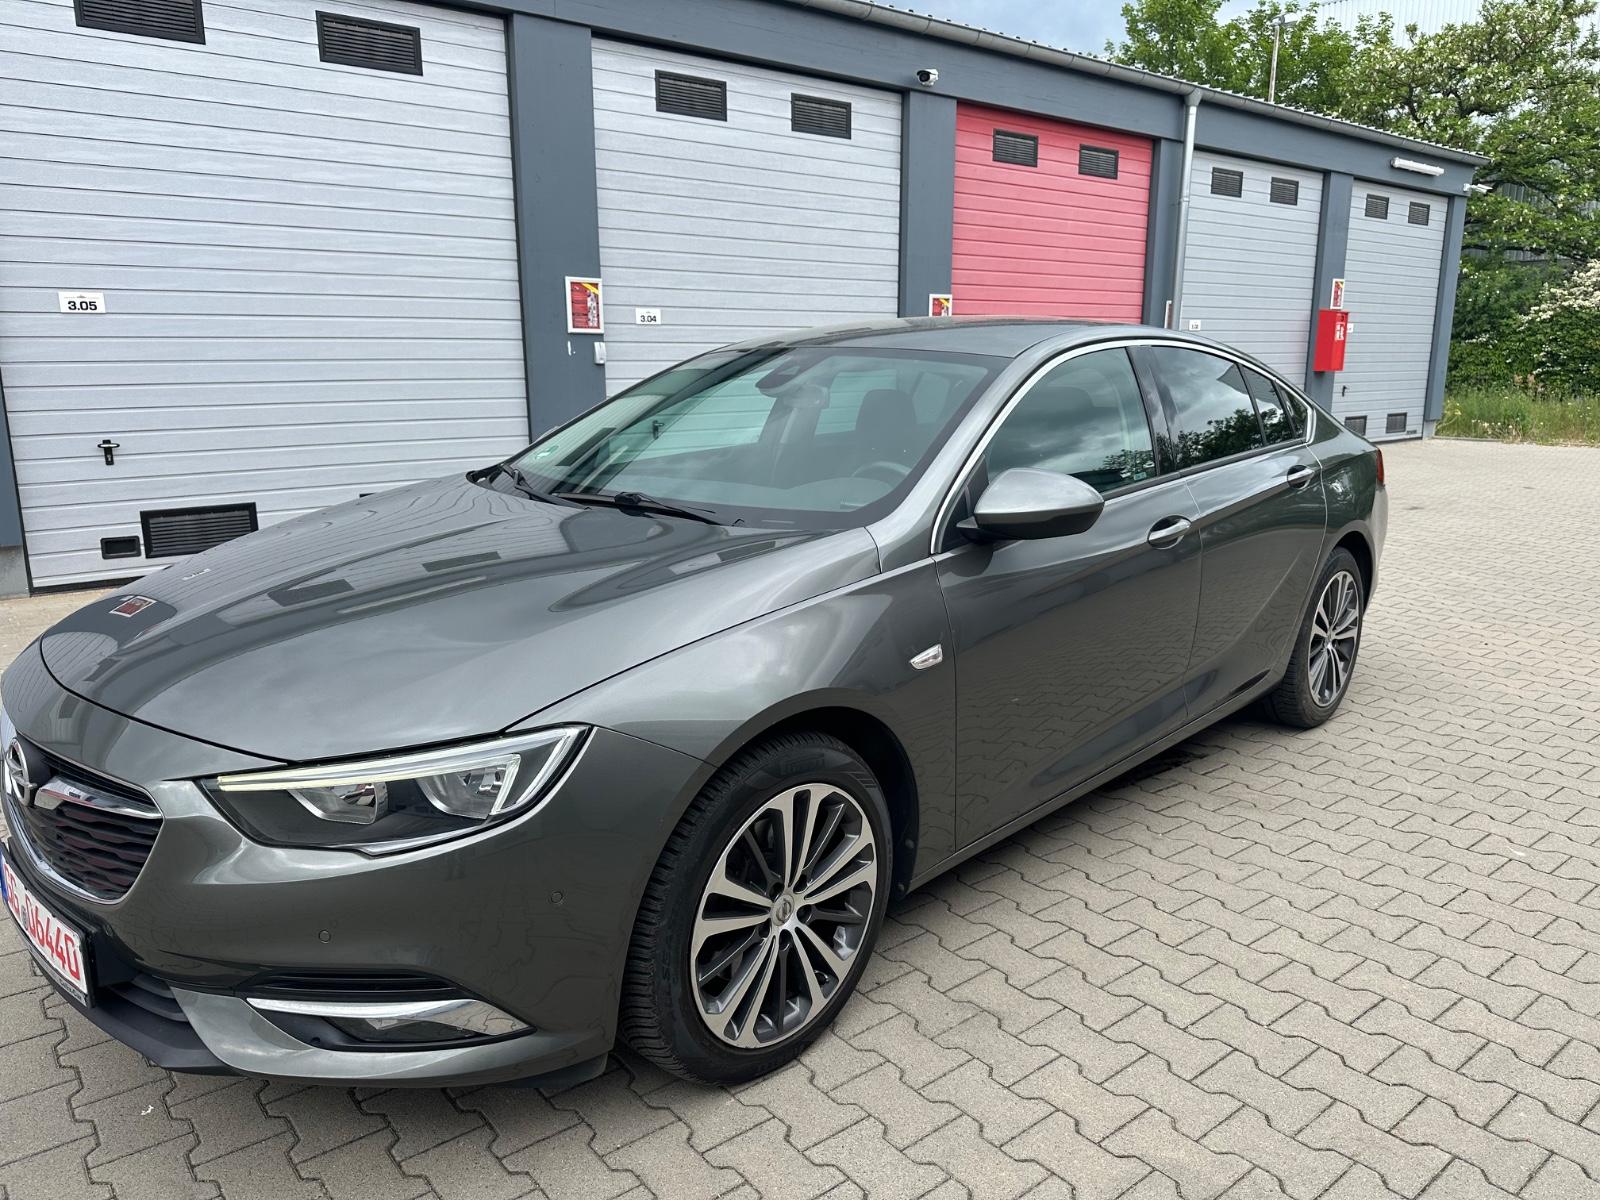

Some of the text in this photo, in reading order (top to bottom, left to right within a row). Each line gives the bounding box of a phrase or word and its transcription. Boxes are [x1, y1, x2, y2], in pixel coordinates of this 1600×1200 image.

[67, 300, 98, 311] 3.05
[640, 314, 657, 323] 3.04
[25, 895, 81, 981] 06440
